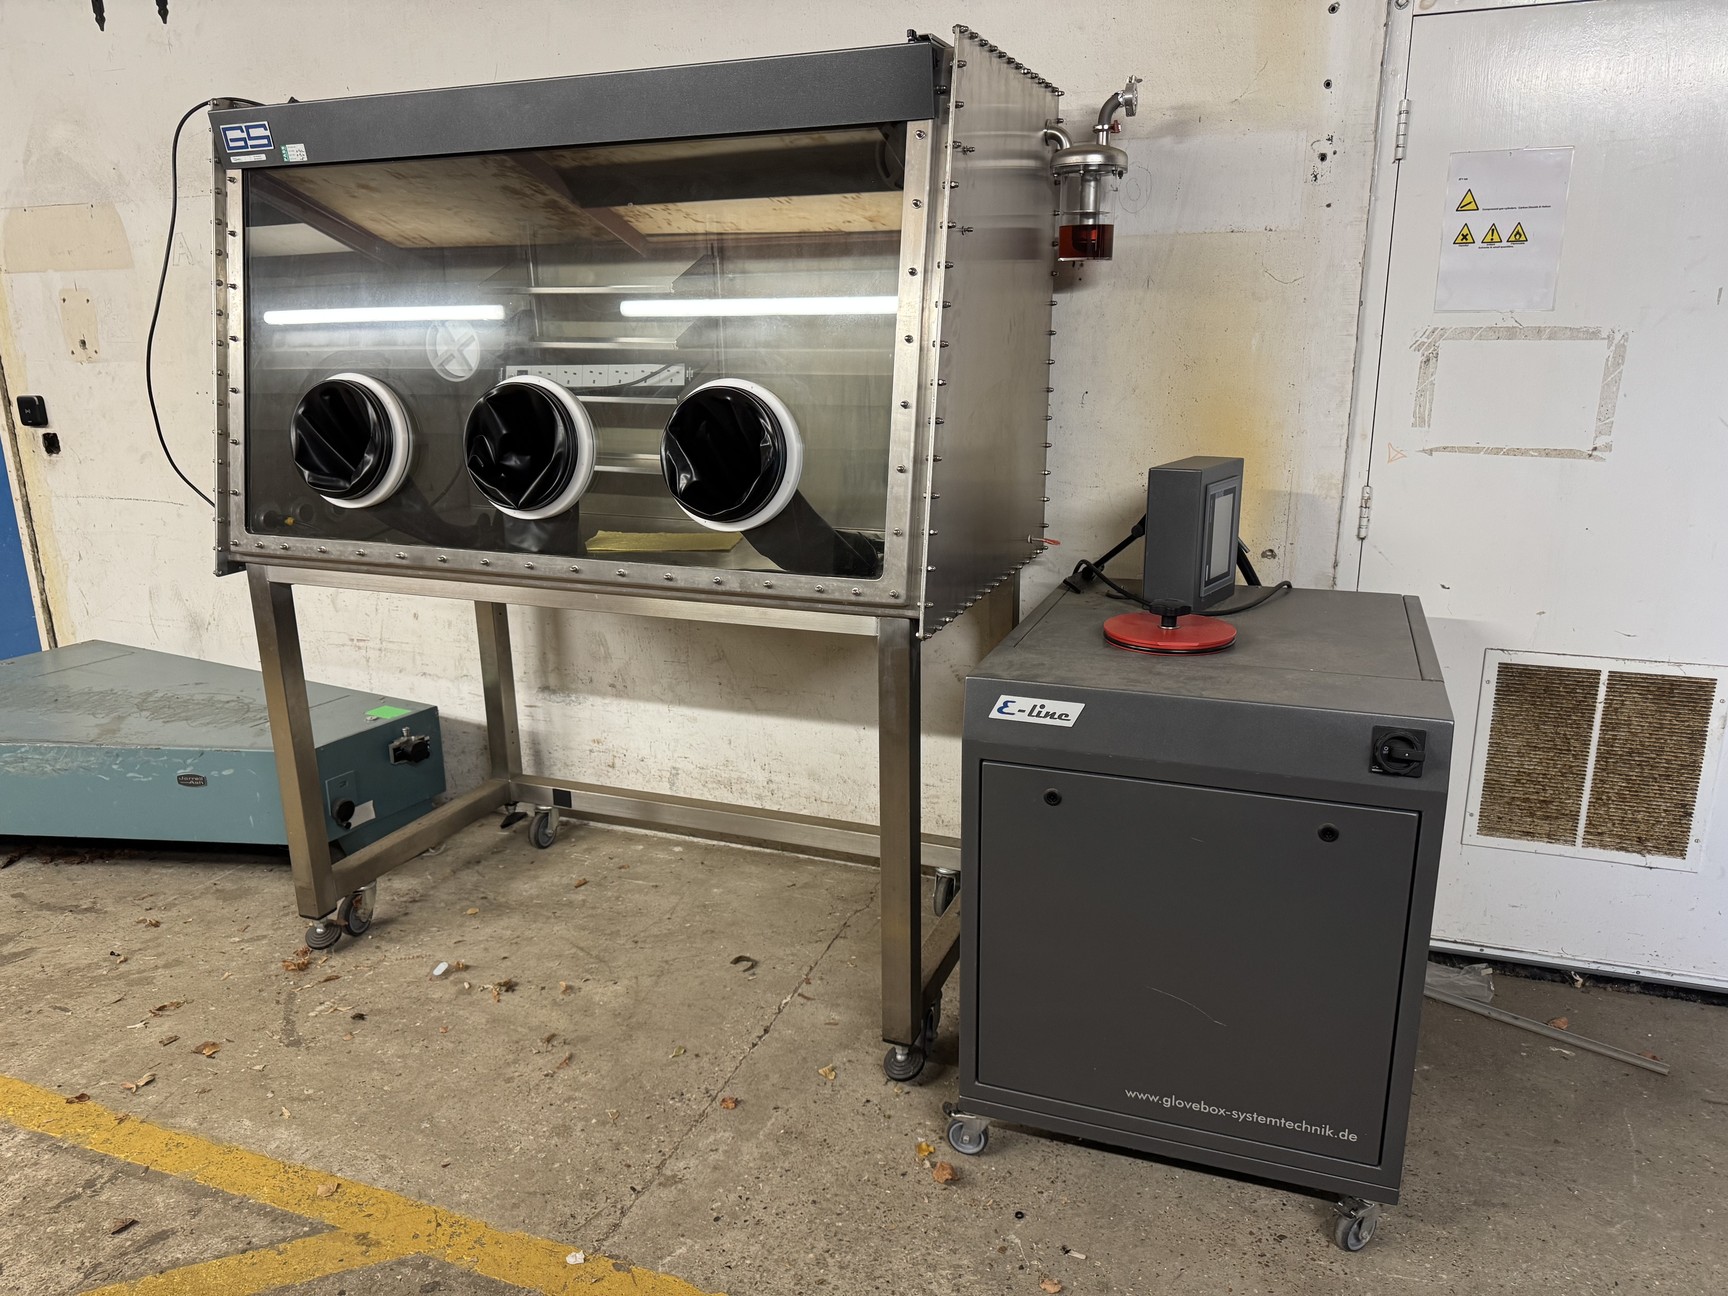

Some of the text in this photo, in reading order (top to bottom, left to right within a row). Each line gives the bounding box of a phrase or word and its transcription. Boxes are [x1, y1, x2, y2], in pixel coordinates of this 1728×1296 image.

[221, 123, 273, 151] GS
[996, 700, 1071, 722] E-line
[1125, 1089, 1358, 1142] www.glovebox-systemtechnik.de
